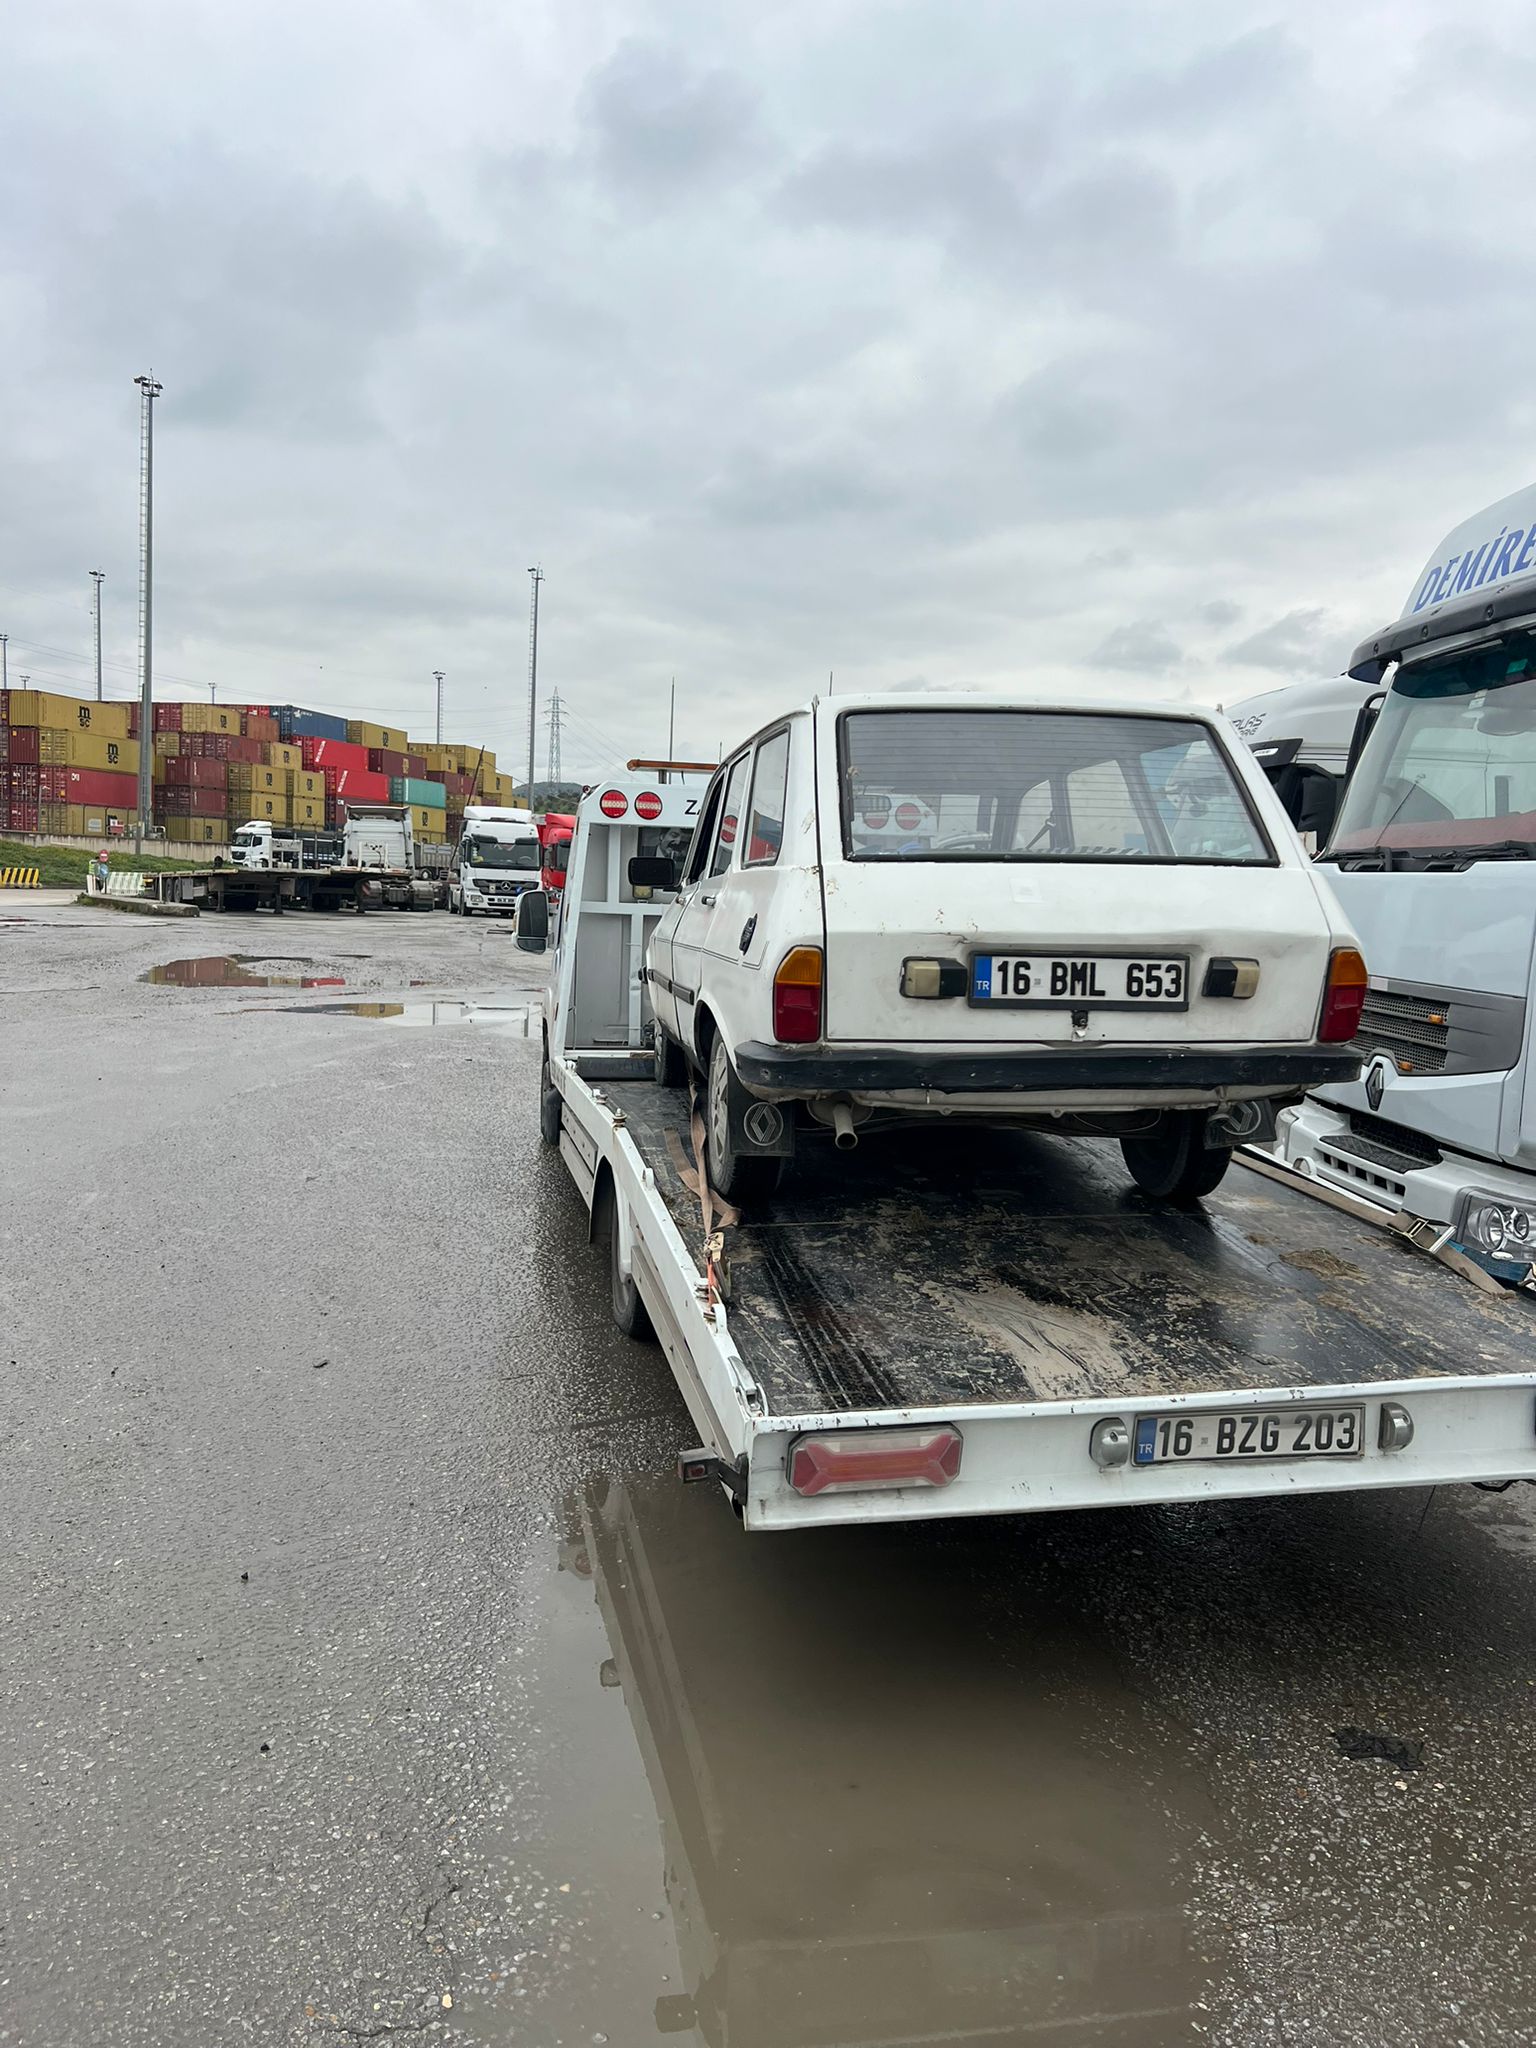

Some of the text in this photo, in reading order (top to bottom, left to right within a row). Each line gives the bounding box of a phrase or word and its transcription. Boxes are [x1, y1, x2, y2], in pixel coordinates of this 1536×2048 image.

[1411, 523, 1536, 614] DEMİRE
[684, 799, 701, 815] Z
[976, 961, 1182, 998] TR 16 BML 653
[1138, 1412, 1356, 1457] TR 16 BZG 203
